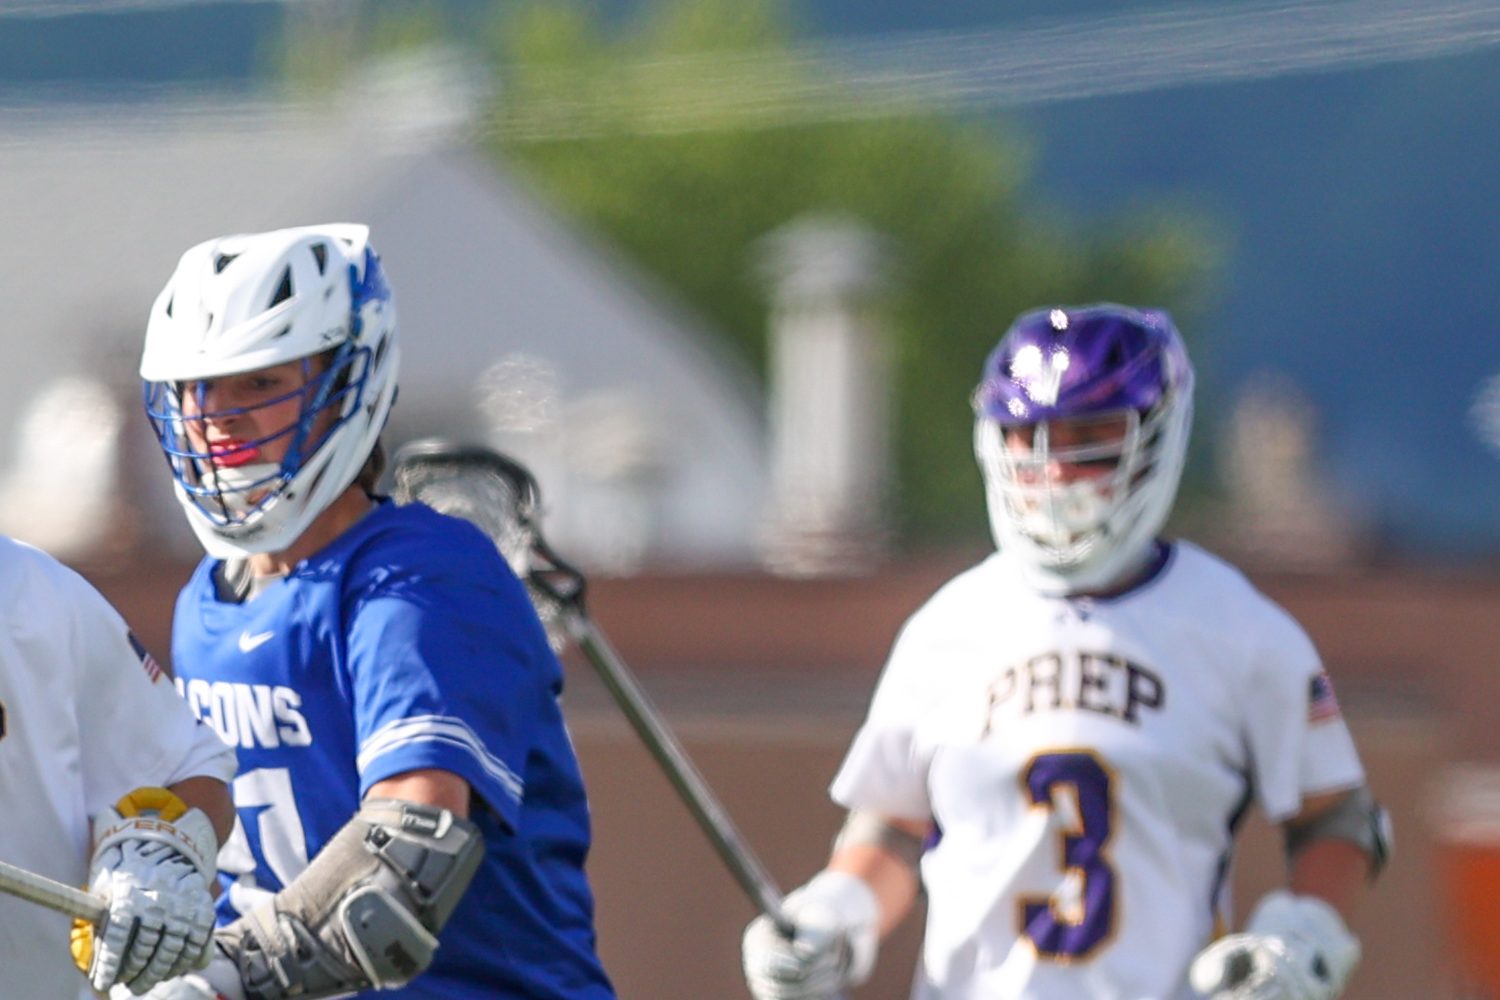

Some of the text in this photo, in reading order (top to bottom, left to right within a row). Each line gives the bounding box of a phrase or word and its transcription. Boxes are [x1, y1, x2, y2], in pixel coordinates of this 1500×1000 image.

[174, 676, 313, 749] CONS
[981, 649, 1166, 740] PREP
[1015, 748, 1120, 964] 3
